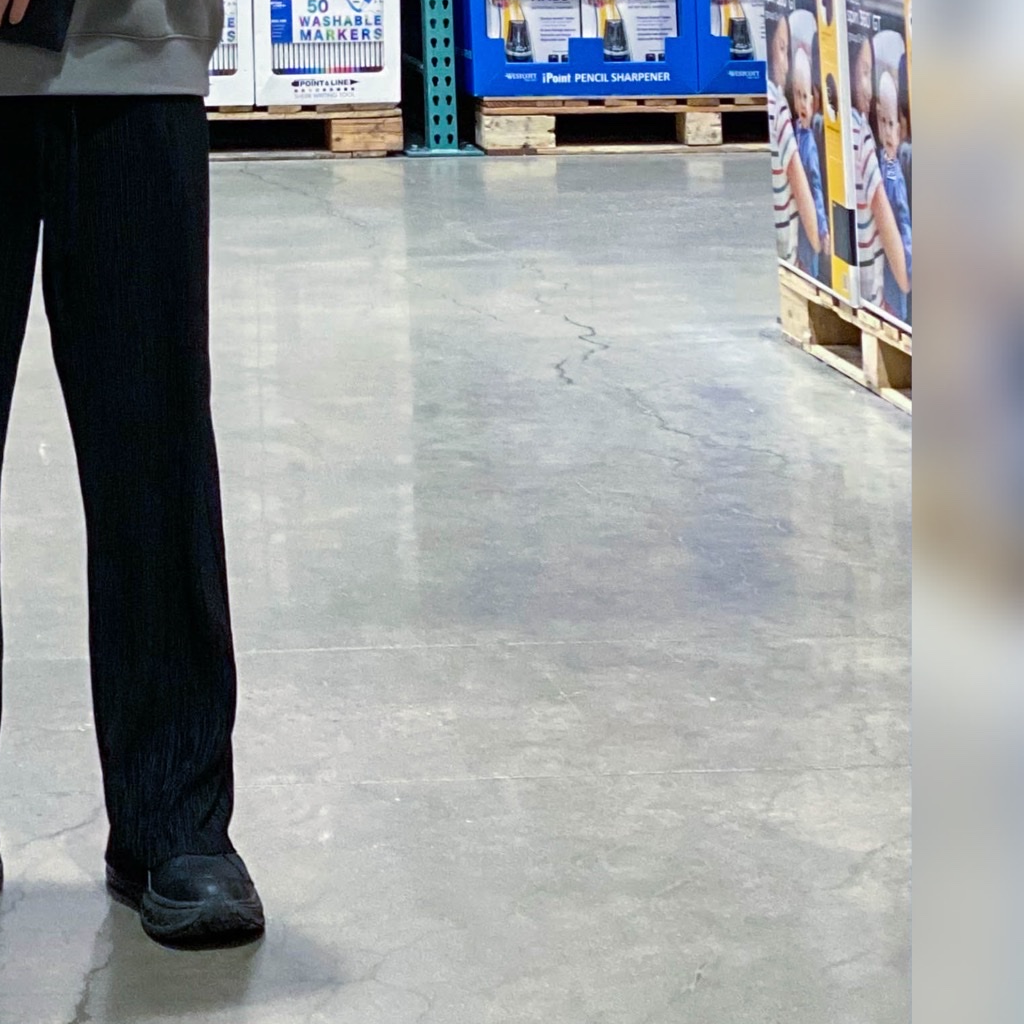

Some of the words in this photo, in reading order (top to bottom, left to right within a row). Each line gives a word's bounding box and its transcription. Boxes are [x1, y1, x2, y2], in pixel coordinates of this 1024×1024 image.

[307, 0, 328, 13] 50
[299, 15, 382, 27] WASHABLE
[300, 28, 382, 41] MARKERS
[542, 72, 571, 84] iPoint
[574, 72, 608, 83] PENCIL
[611, 71, 670, 82] SHARPENER
